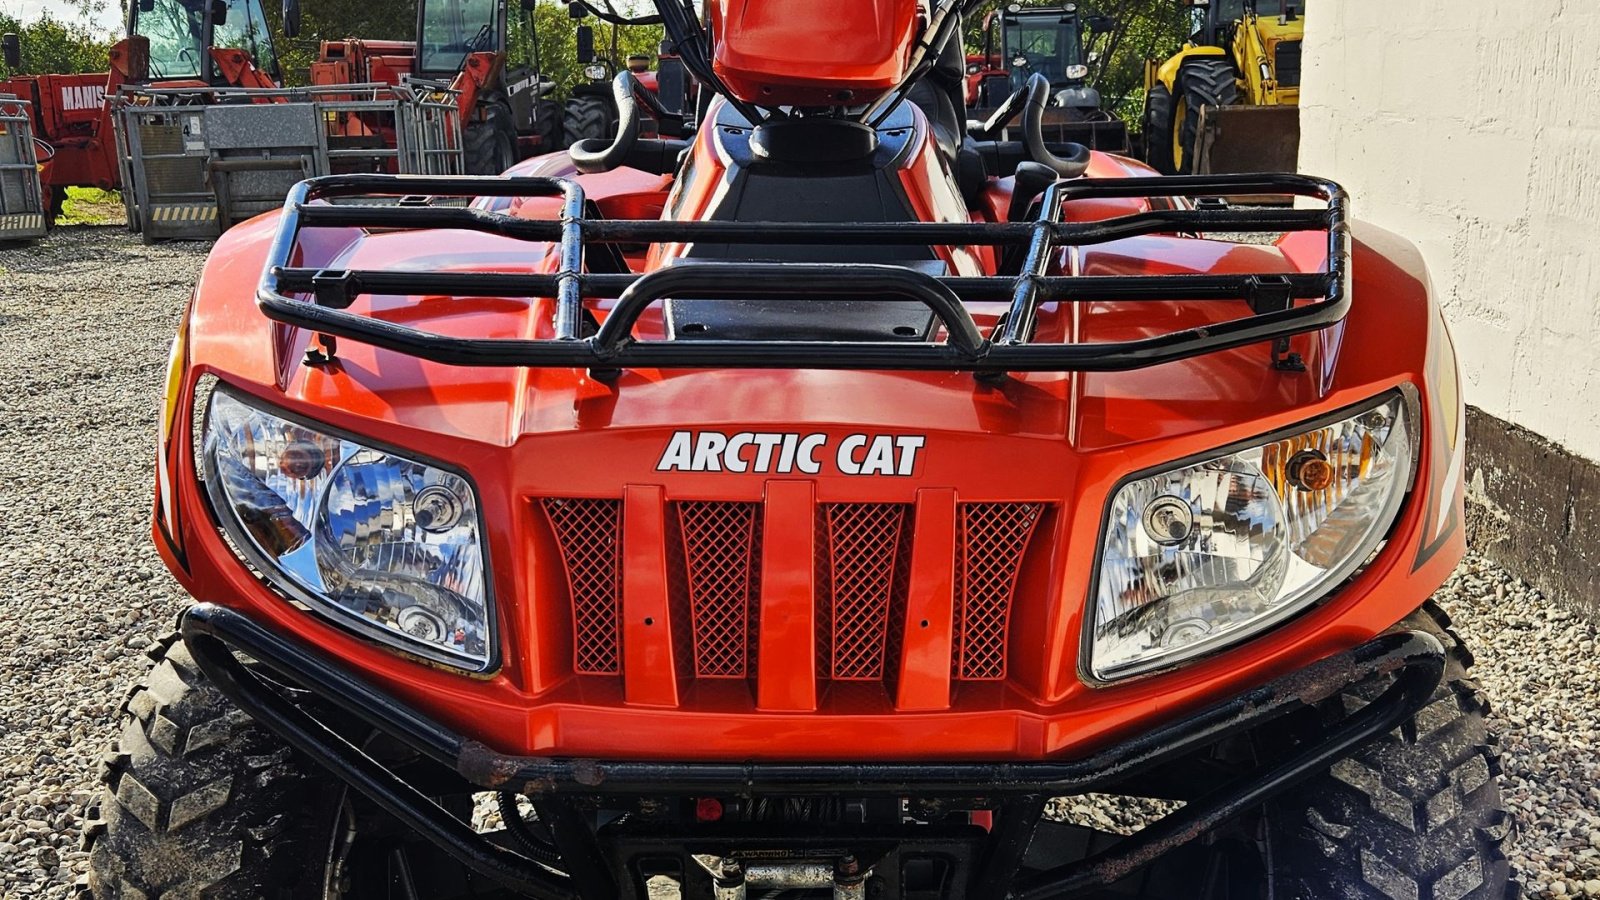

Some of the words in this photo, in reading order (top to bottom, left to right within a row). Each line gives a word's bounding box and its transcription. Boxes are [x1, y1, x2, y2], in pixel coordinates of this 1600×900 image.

[183, 124, 190, 137] 4
[656, 430, 828, 474] ARCTIC
[836, 433, 926, 476] CAT
